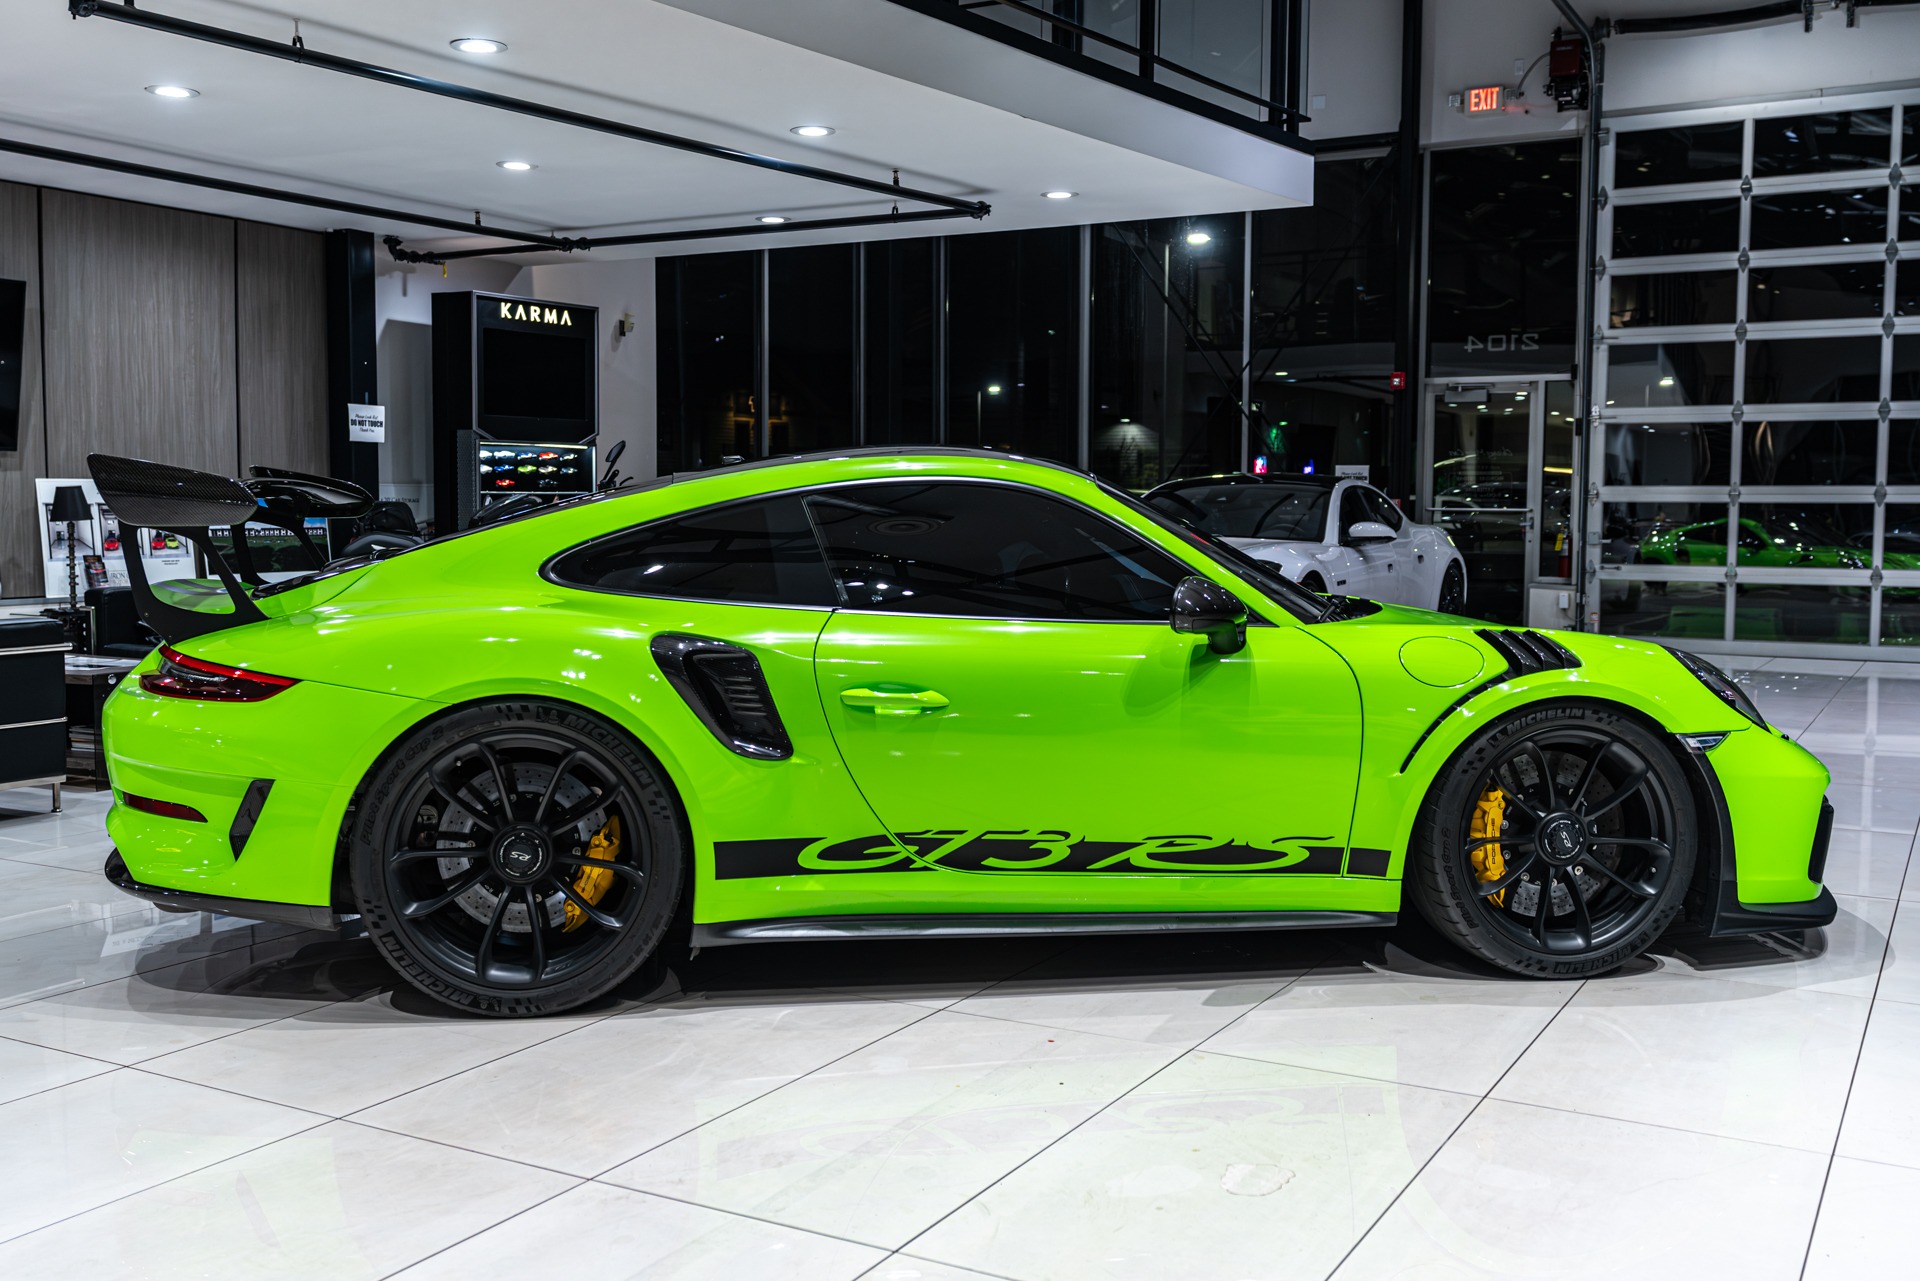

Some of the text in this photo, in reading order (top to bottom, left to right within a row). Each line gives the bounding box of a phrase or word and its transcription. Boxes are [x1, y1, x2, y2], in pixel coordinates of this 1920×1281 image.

[1470, 87, 1499, 112] EXIT
[501, 302, 572, 326] KARMA
[358, 419, 367, 427] NOT
[1507, 707, 1584, 735] MICHELIN
[374, 758, 406, 802] Sport
[405, 737, 431, 761] Cup
[432, 725, 444, 741] 2
[564, 714, 653, 786] MICHELIN
[1442, 827, 1451, 838] 2
[1442, 839, 1451, 863] Cup
[1444, 865, 1460, 901] Sport
[381, 935, 475, 1006] MICHELIN
[1555, 945, 1632, 974] MICHELIN
